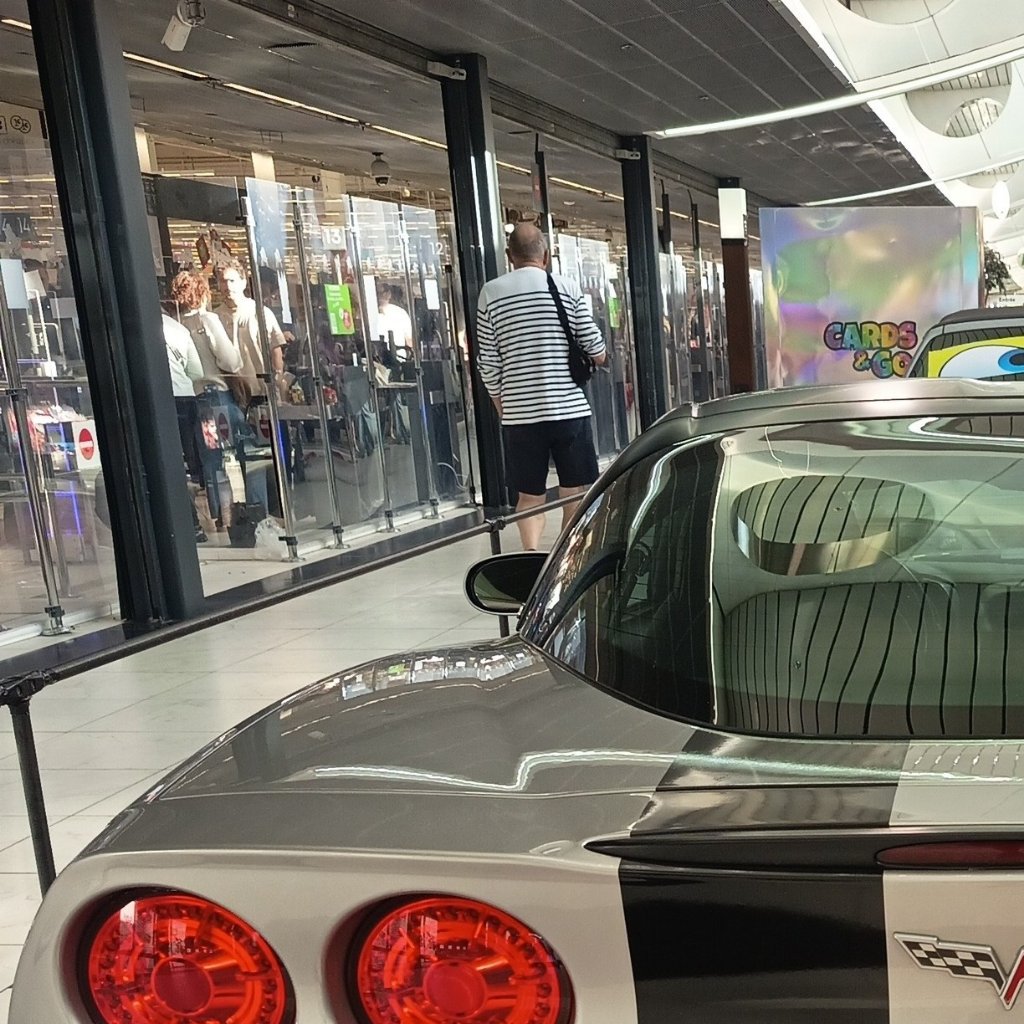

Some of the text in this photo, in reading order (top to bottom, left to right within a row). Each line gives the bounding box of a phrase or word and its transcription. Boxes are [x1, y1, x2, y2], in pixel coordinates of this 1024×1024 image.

[823, 321, 918, 351] CARDS
[852, 349, 913, 379] & GO
